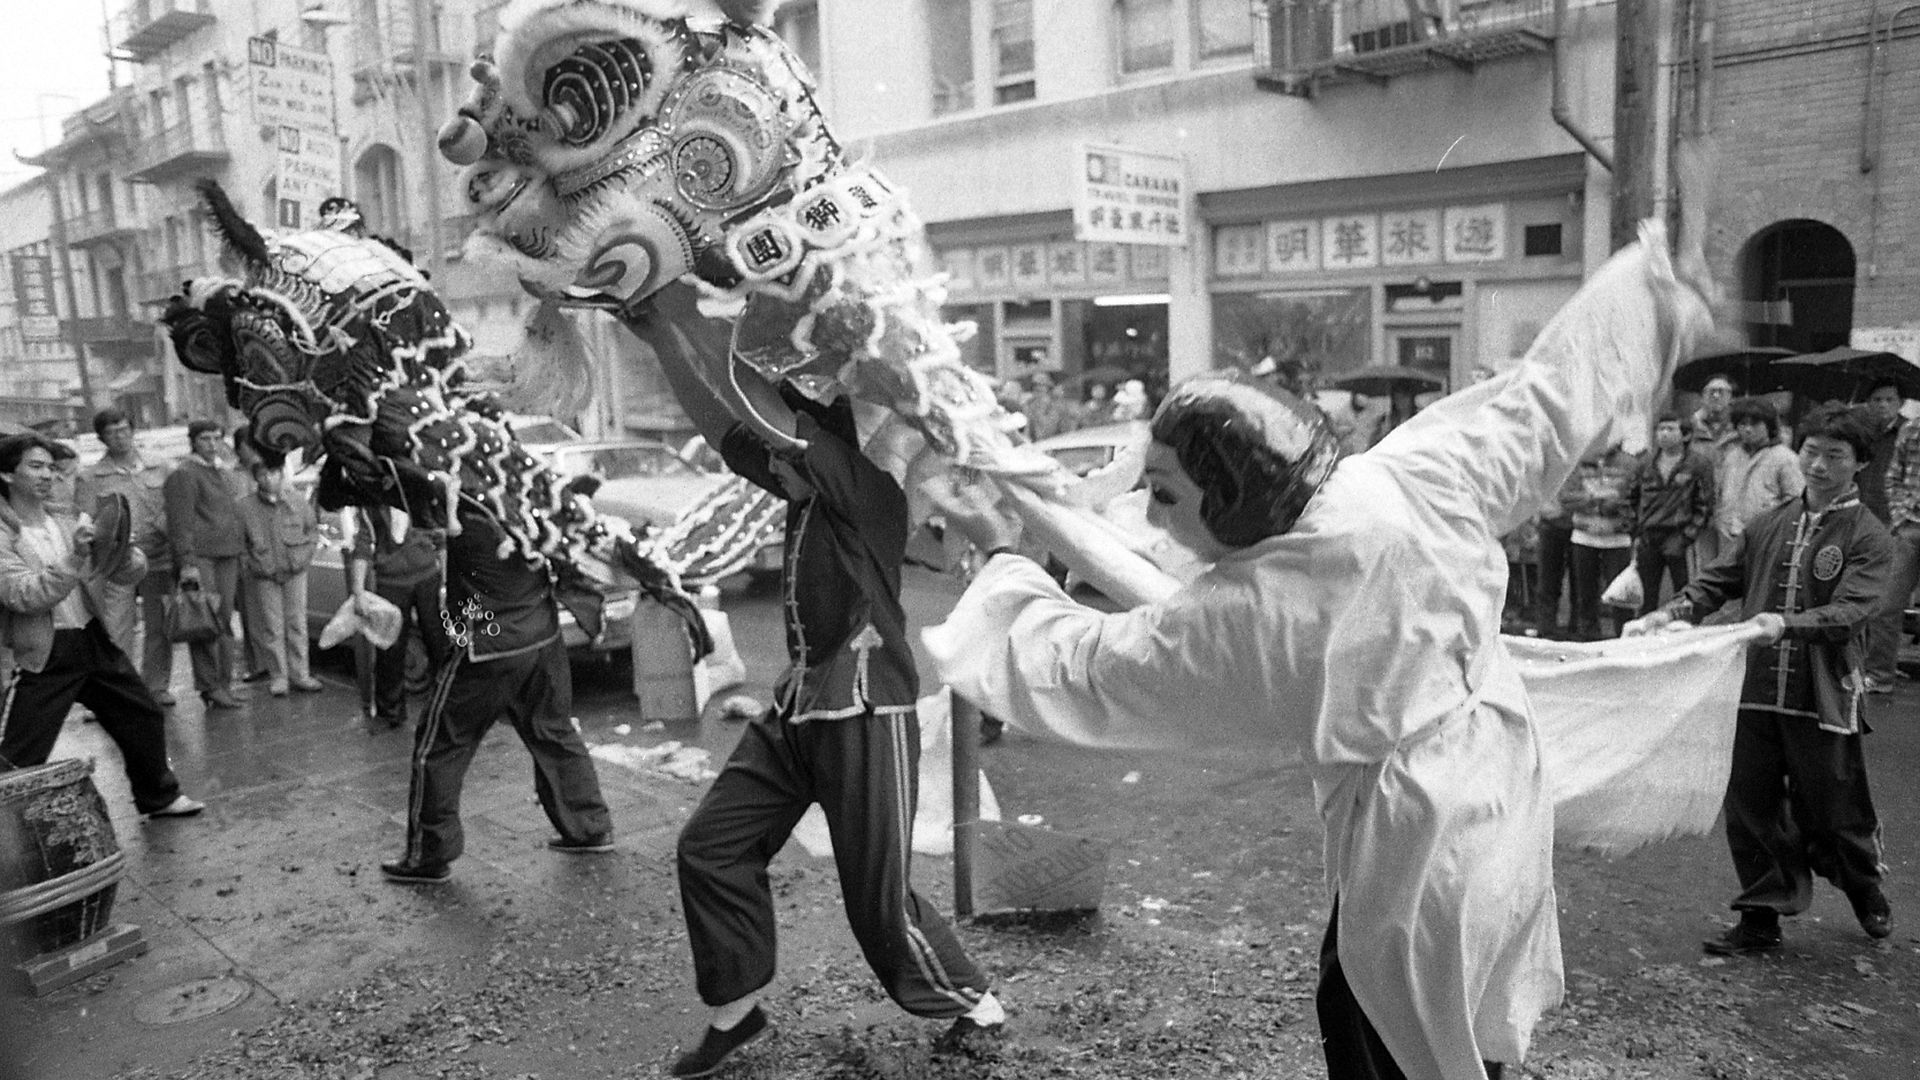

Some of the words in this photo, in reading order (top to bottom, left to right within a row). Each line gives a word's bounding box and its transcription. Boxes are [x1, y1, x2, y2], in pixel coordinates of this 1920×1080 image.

[250, 39, 274, 66] NO
[279, 52, 327, 77] PARKING
[1273, 216, 1495, 264] 明華旅遊
[982, 828, 1034, 862] NO
